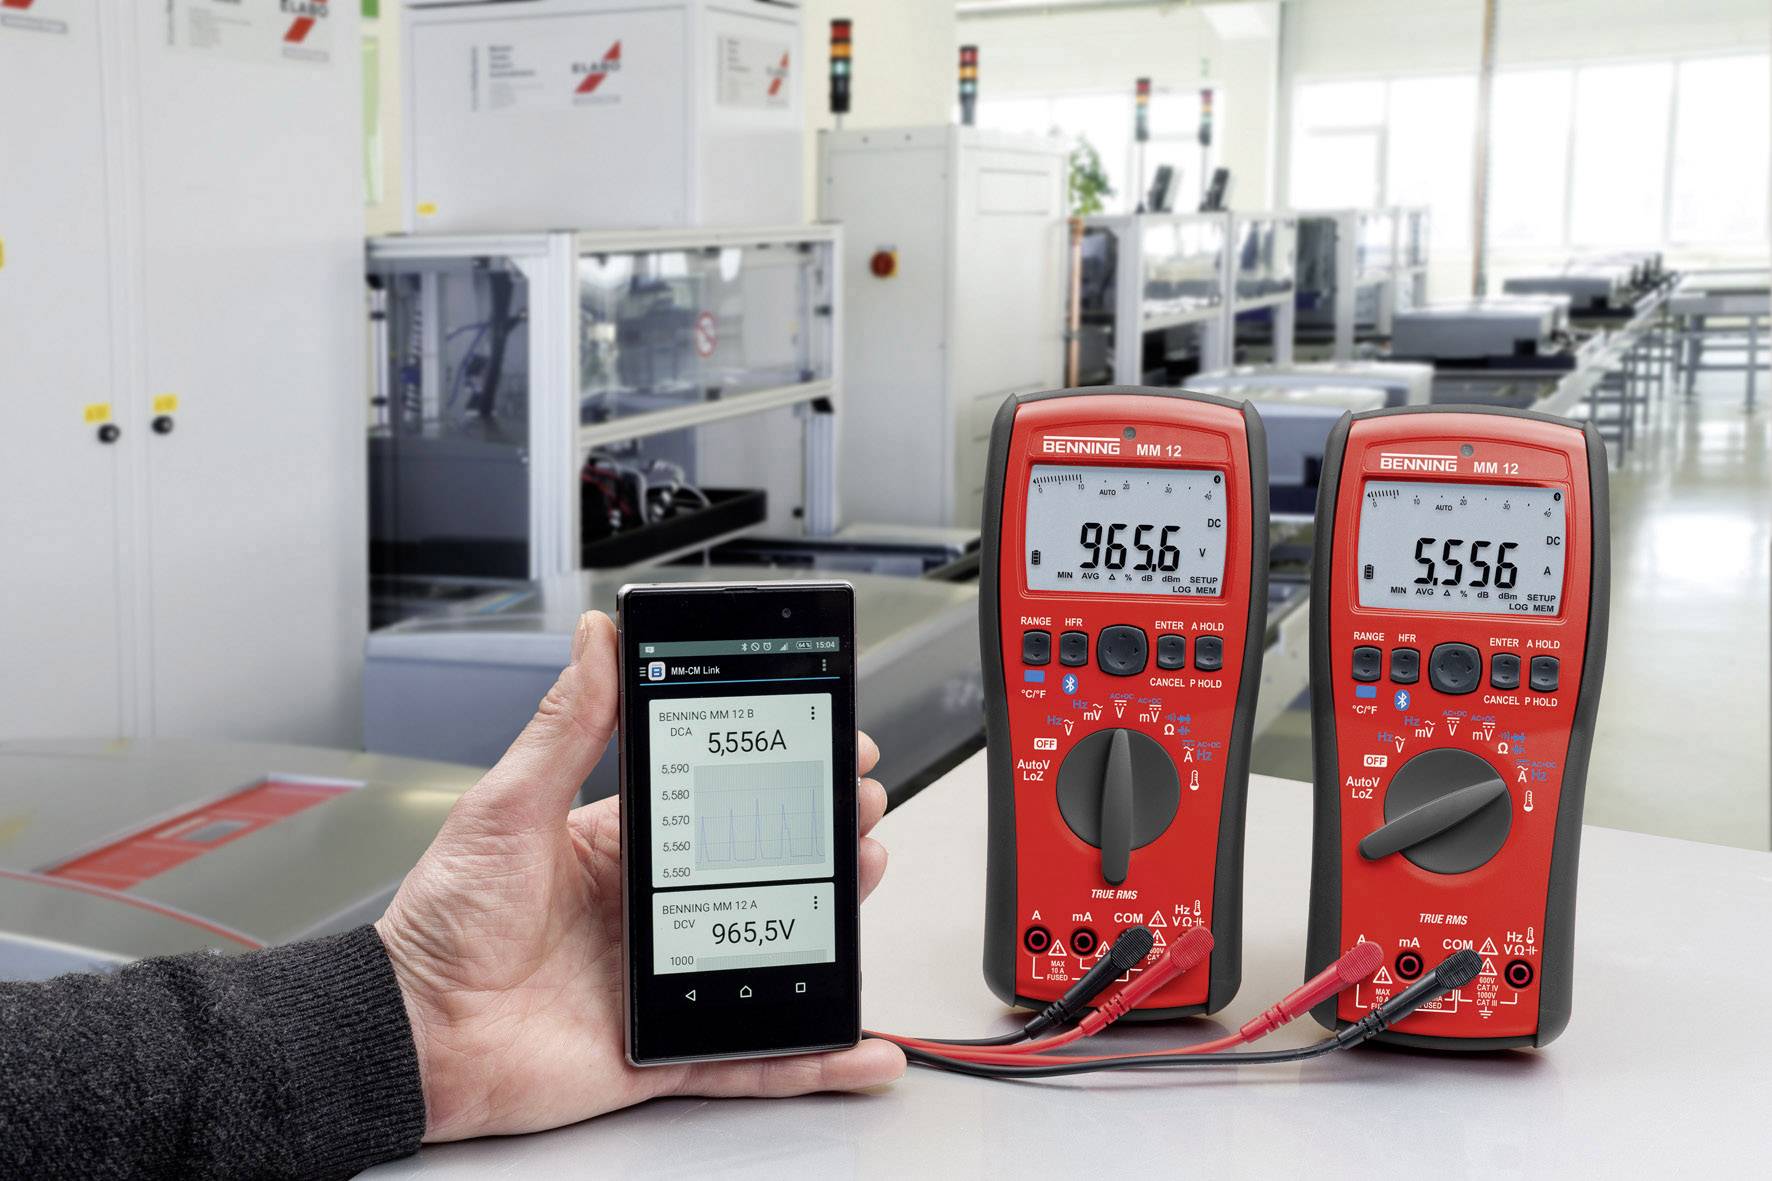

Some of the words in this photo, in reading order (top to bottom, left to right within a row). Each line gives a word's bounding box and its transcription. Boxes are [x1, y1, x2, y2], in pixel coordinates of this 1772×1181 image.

[1043, 440, 1120, 455] BENNING
[1136, 444, 1161, 457] MM
[1166, 445, 1182, 457] 12
[1380, 457, 1457, 472] BENNING
[1473, 461, 1498, 474] MM
[1503, 462, 1519, 475] 12
[1164, 486, 1172, 494] 30
[1435, 504, 1453, 512] AUTO
[1459, 498, 1467, 506] 20
[1502, 503, 1511, 511] 30
[1207, 518, 1222, 528] DC
[1546, 536, 1560, 546] DC
[1079, 522, 1181, 572] 965.6
[1199, 548, 1206, 558] V
[1413, 537, 1519, 589] 5.556
[1543, 566, 1551, 576] A
[1057, 571, 1073, 579] MIN
[1081, 572, 1099, 580] AVG
[1141, 574, 1153, 582] dB
[1161, 575, 1181, 583] dBm
[1189, 576, 1218, 584] SETUP
[1195, 586, 1216, 594] MEM
[1390, 586, 1407, 594] MIN
[1415, 587, 1434, 596] AVG
[1459, 590, 1467, 598] %
[1477, 591, 1489, 599] dB
[1498, 592, 1517, 601] dBm
[1527, 594, 1556, 602] SETUP
[1509, 603, 1528, 611] LOG
[1533, 604, 1554, 612] MEM
[1020, 616, 1052, 626] RANGE
[1064, 618, 1083, 627] HFR
[1155, 621, 1184, 630] ENTER
[1191, 622, 1198, 631] A
[1200, 622, 1224, 631] HOLD
[1353, 631, 1385, 641] RANGE
[1398, 633, 1417, 643] HFR
[816, 640, 835, 649] 15:04
[1489, 638, 1519, 648] ENTER
[1526, 639, 1533, 648] A
[1535, 640, 1560, 649] HOLD
[671, 666, 701, 676] MM-CM
[703, 665, 721, 675] Link
[1150, 677, 1185, 688] CANCEL
[1190, 678, 1196, 688] P
[1197, 679, 1222, 689] HOLD
[1073, 700, 1088, 709] Hz
[1483, 695, 1520, 706] CANCEL
[1524, 696, 1531, 706] P
[1532, 697, 1558, 707] HOLD
[658, 710, 707, 723] BENNING
[709, 709, 729, 720] MM
[732, 709, 745, 719] 12
[747, 708, 754, 719] B
[1047, 716, 1062, 725] Hz
[1083, 709, 1102, 721] mV
[1139, 711, 1160, 723] mV
[1404, 716, 1420, 726] Hz
[670, 726, 693, 737] DCA
[1164, 723, 1175, 735] Ω
[1415, 726, 1434, 738] mV
[1377, 731, 1393, 742] Hz
[1472, 729, 1494, 742] mV
[707, 729, 787, 757] 5,556A
[1036, 740, 1055, 748] OFF
[1497, 742, 1509, 754] Ω
[1184, 750, 1193, 763] A
[1365, 756, 1385, 766] OFF
[1017, 759, 1050, 770] AutoV
[1023, 771, 1044, 781] LoZ
[1517, 770, 1528, 783] A
[1346, 776, 1380, 788] AutoV
[1351, 788, 1373, 799] LoZ
[1091, 889, 1115, 899] TRUE
[1116, 890, 1138, 900] RMS
[662, 903, 710, 915] BENNING
[712, 901, 732, 912] MM
[735, 901, 748, 911] 12
[749, 900, 758, 910] A
[1175, 904, 1190, 915] Hz
[1031, 910, 1042, 920] A
[1072, 912, 1093, 922] mA
[1113, 913, 1143, 923] COM
[1419, 913, 1445, 924] TRUE
[1445, 914, 1468, 926] RMS
[673, 919, 696, 930] DCV
[712, 918, 796, 946] 965,5V
[1506, 931, 1523, 943] Hz
[1399, 937, 1420, 948] mA
[1442, 938, 1473, 951] COM
[670, 955, 694, 966] 1000
[1479, 976, 1496, 984] 600V
[1477, 991, 1496, 999] 1000V
[1419, 1001, 1442, 1009] USED
[1476, 998, 1490, 1006] CAT
